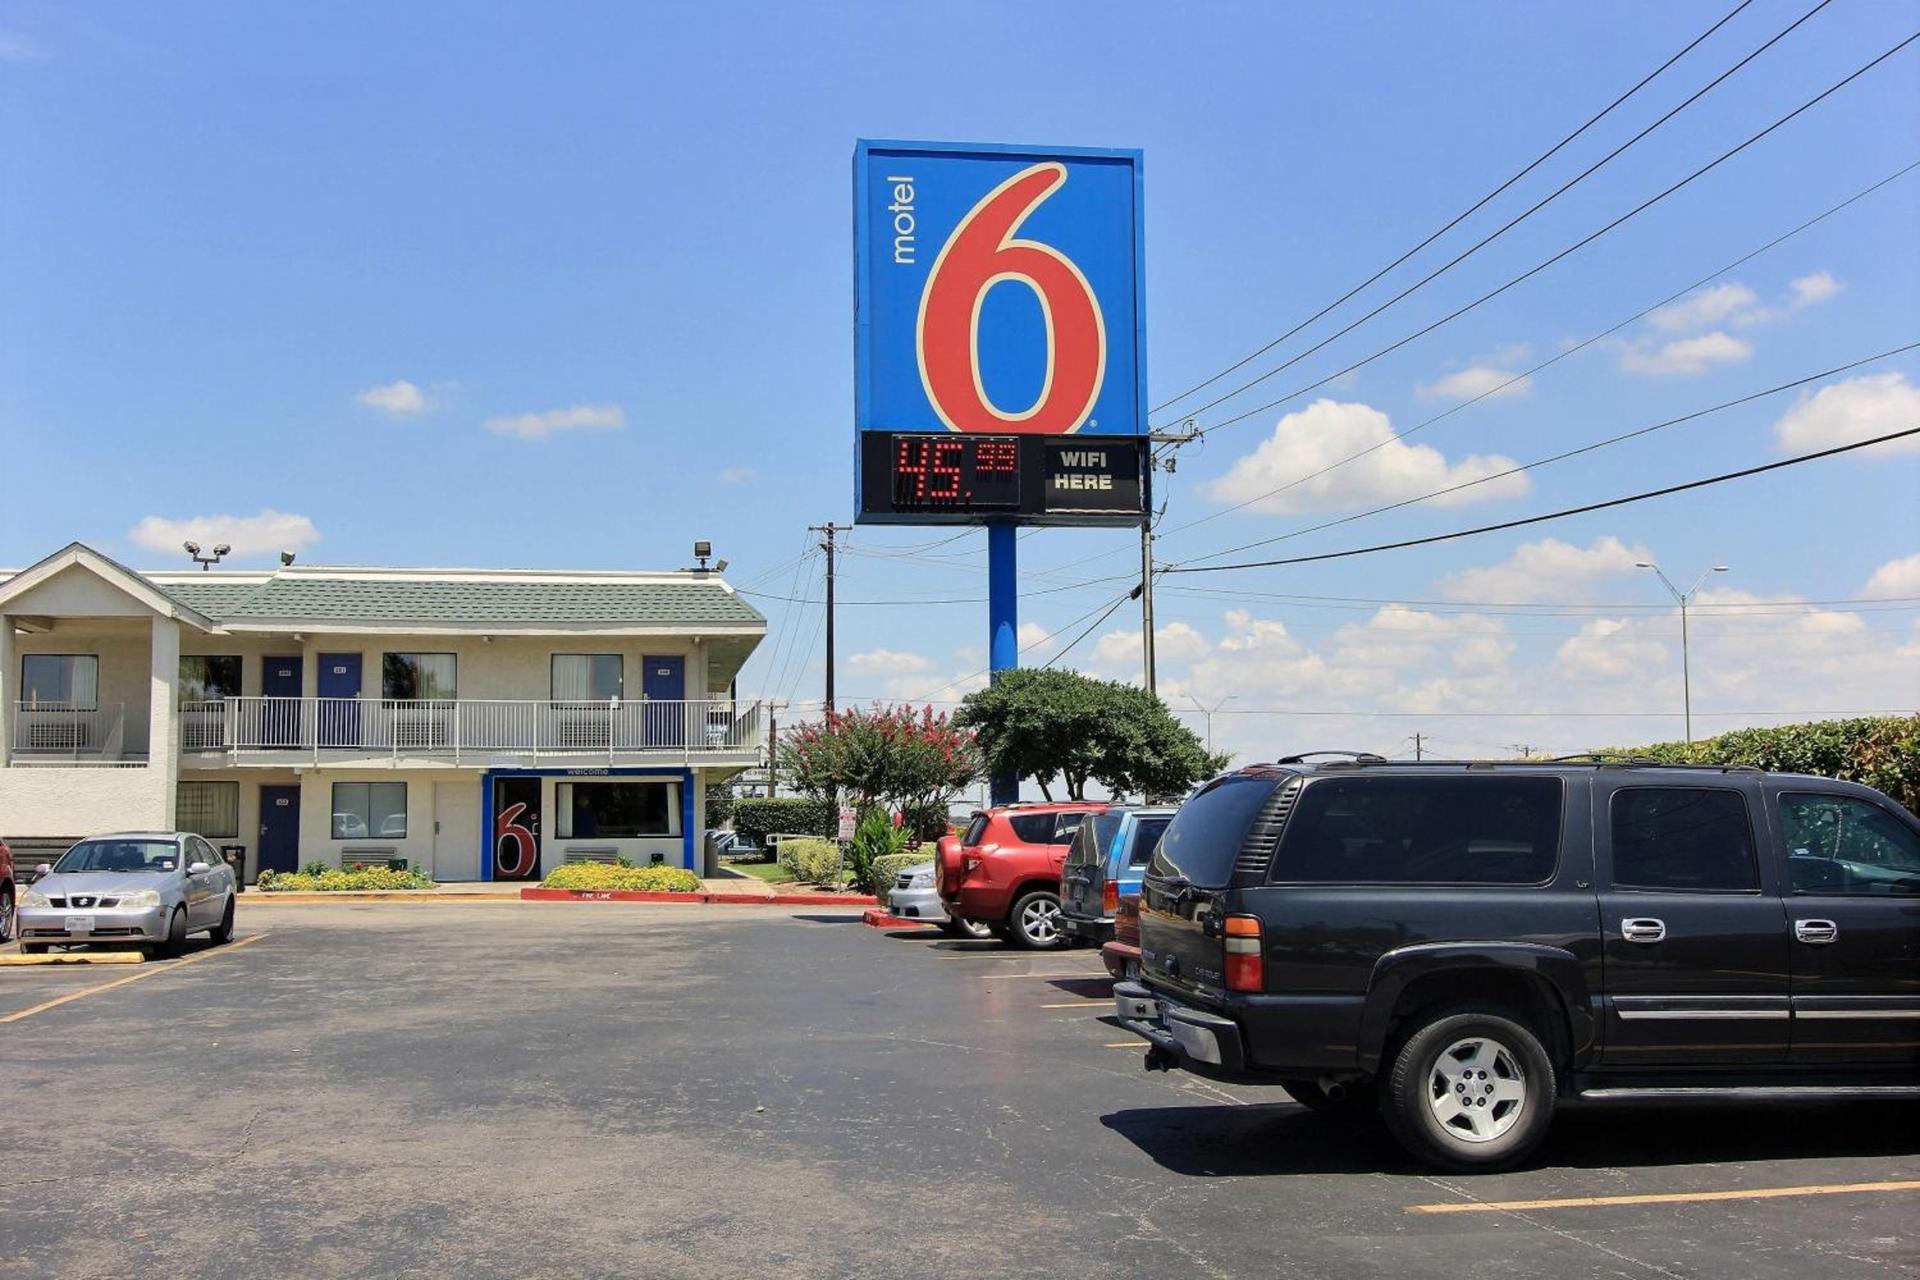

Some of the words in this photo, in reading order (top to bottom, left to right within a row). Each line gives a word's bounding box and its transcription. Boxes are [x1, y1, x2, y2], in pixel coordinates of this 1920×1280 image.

[888, 176, 915, 264] motel
[916, 161, 1106, 434] 6
[1054, 473, 1113, 490] HERE
[1060, 451, 1106, 468] WIFI
[497, 802, 537, 876] 6
